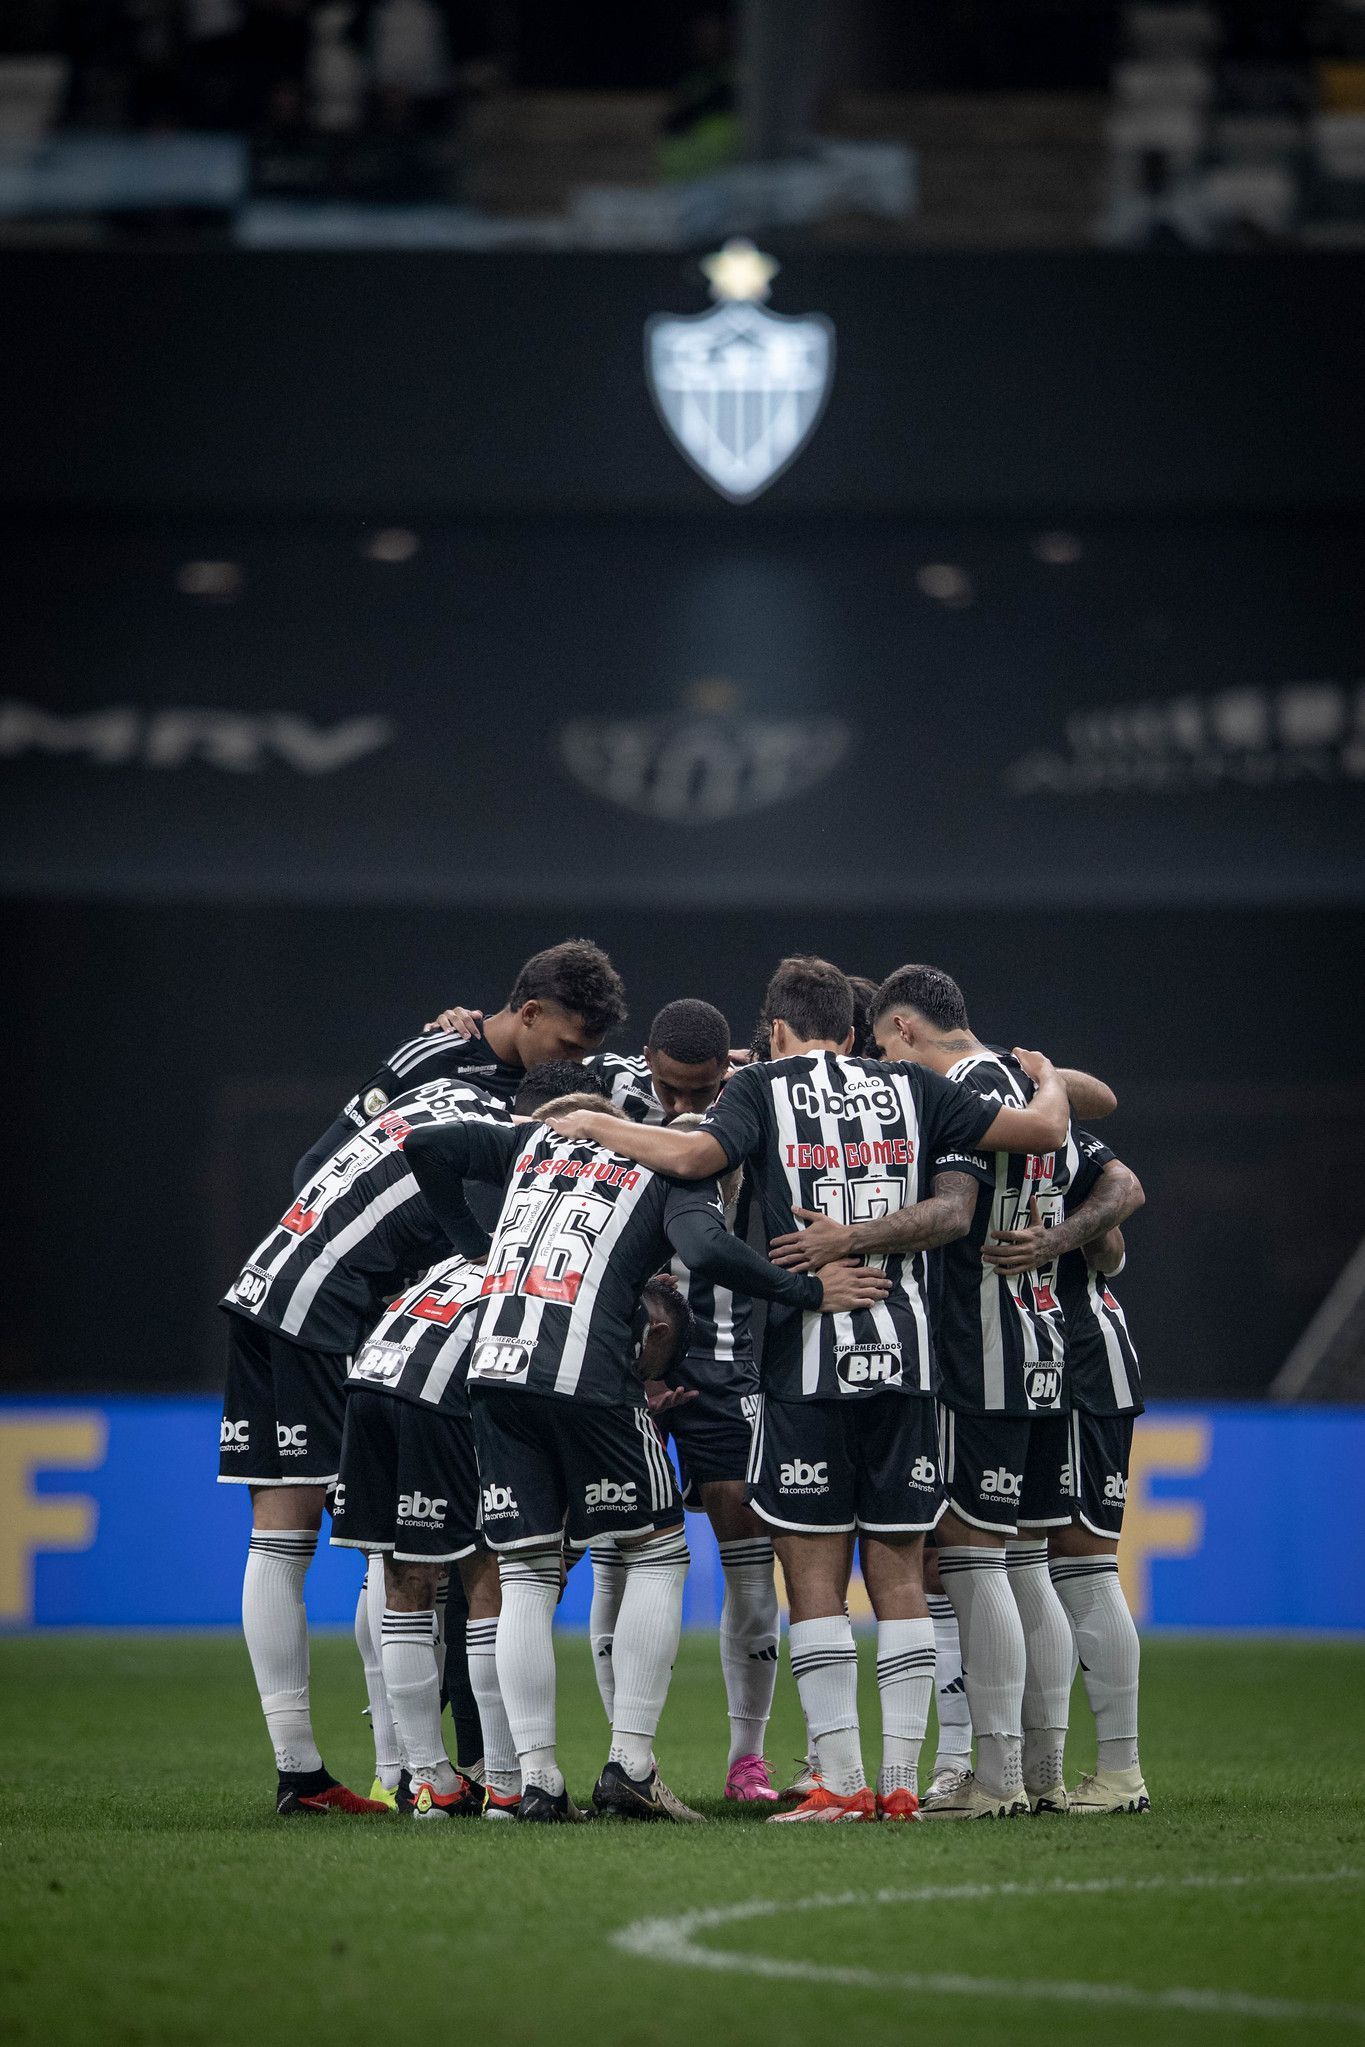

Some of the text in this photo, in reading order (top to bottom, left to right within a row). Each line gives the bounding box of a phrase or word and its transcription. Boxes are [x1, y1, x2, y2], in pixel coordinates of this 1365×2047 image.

[847, 1079, 880, 1091] GALO
[820, 1088, 897, 1121] bmg
[785, 1139, 915, 1169] IGOR GOMES
[935, 1153, 987, 1171] GERDAU
[479, 1188, 616, 1306] 26
[236, 1272, 266, 1304] BH
[475, 1344, 524, 1373] BH
[833, 1342, 903, 1353] SUPERMERCADOS
[359, 1350, 402, 1376] BH
[847, 1353, 892, 1382] BH
[1031, 1371, 1058, 1398] BH
[220, 1416, 249, 1443] bc
[276, 1420, 308, 1448] bc
[779, 1458, 829, 1486] abc
[911, 1455, 936, 1484] ab
[483, 1483, 518, 1512] abc
[584, 1478, 637, 1505] abc
[779, 1485, 830, 1496] da construção
[979, 1492, 989, 1501] da
[397, 1491, 448, 1520] abc
[586, 1503, 638, 1514] da construção
[404, 1518, 444, 1529] construção
